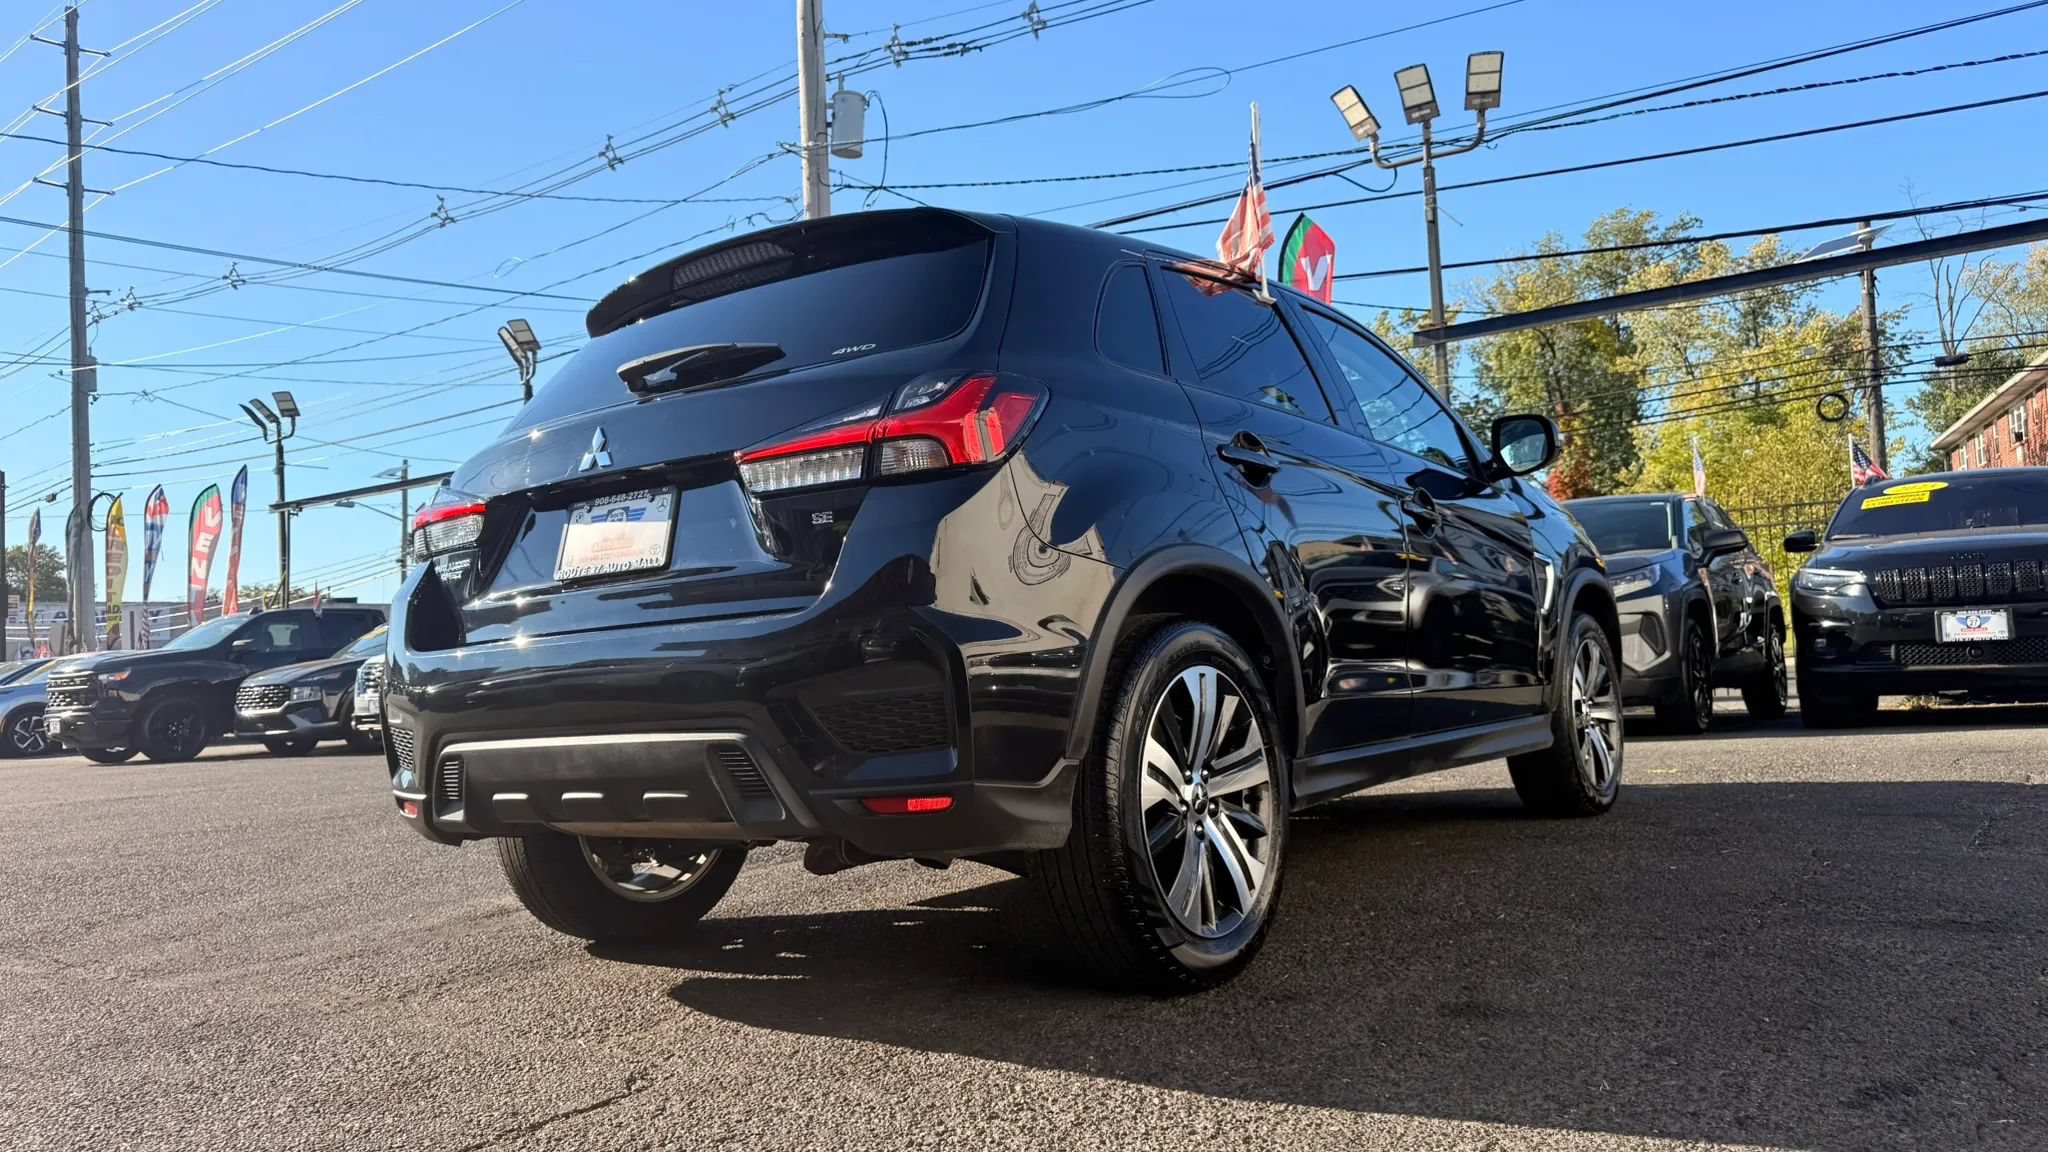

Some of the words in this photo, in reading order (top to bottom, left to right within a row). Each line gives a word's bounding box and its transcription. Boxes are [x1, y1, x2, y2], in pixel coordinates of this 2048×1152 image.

[594, 489, 649, 506] 908-648-2727
[811, 511, 834, 524] SE
[557, 564, 590, 580] ROUTE
[602, 560, 631, 574] AUTO
[632, 557, 662, 571] MALL
